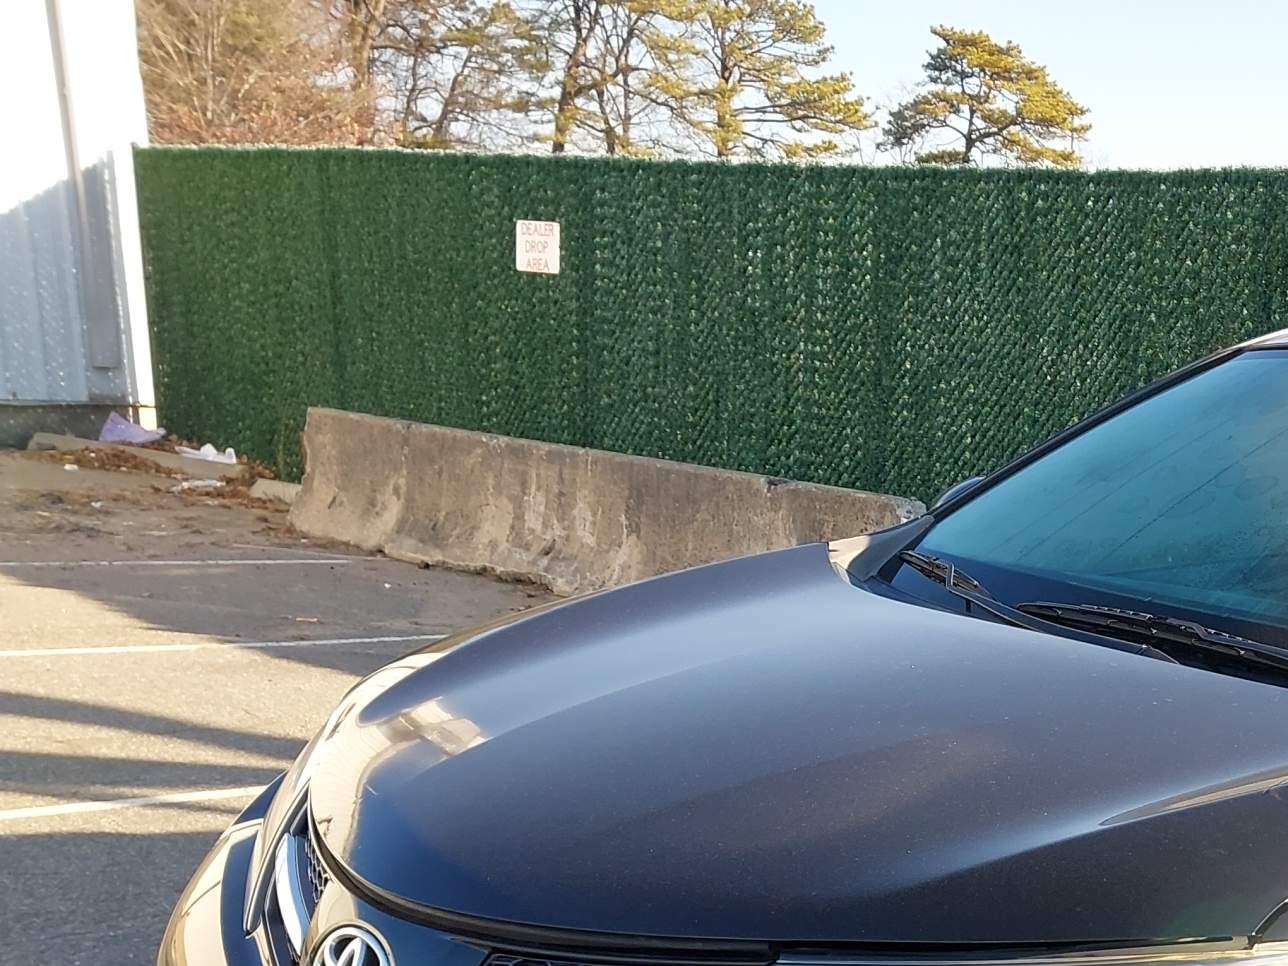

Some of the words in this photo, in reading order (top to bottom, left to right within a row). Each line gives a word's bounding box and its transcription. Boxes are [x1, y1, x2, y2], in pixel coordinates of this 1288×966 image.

[520, 221, 554, 237] DEALER
[525, 240, 549, 253] DROP
[526, 257, 550, 272] AREA
